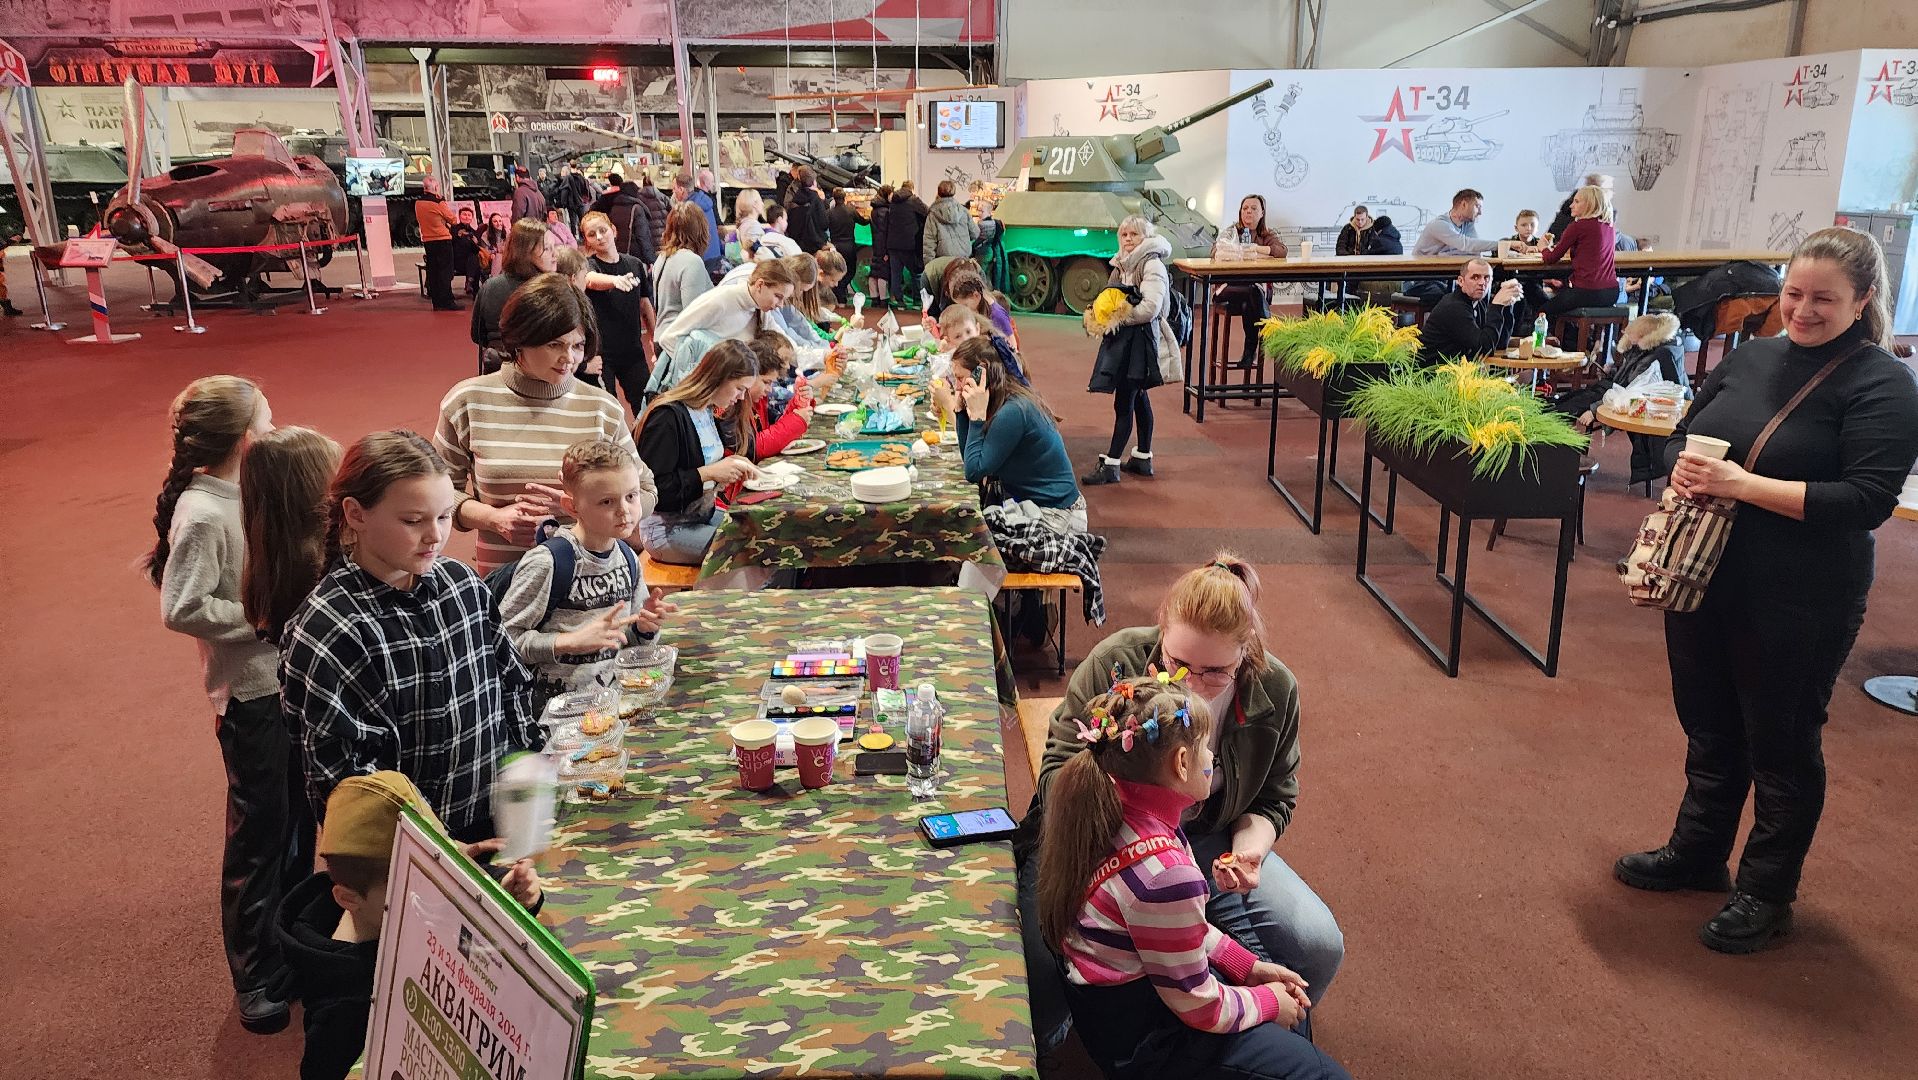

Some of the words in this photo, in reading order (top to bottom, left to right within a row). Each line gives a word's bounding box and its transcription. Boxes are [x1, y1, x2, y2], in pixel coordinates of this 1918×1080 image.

[213, 59, 281, 84] ДУГА
[1892, 60, 1918, 75] Т-3
[84, 105, 124, 117] ПАР
[1409, 85, 1471, 111] Т-34
[1048, 146, 1077, 175] 20
[419, 956, 528, 1080] АКВАГРИМ
[457, 963, 497, 1022] февраля
[497, 1011, 522, 1054] 2024
